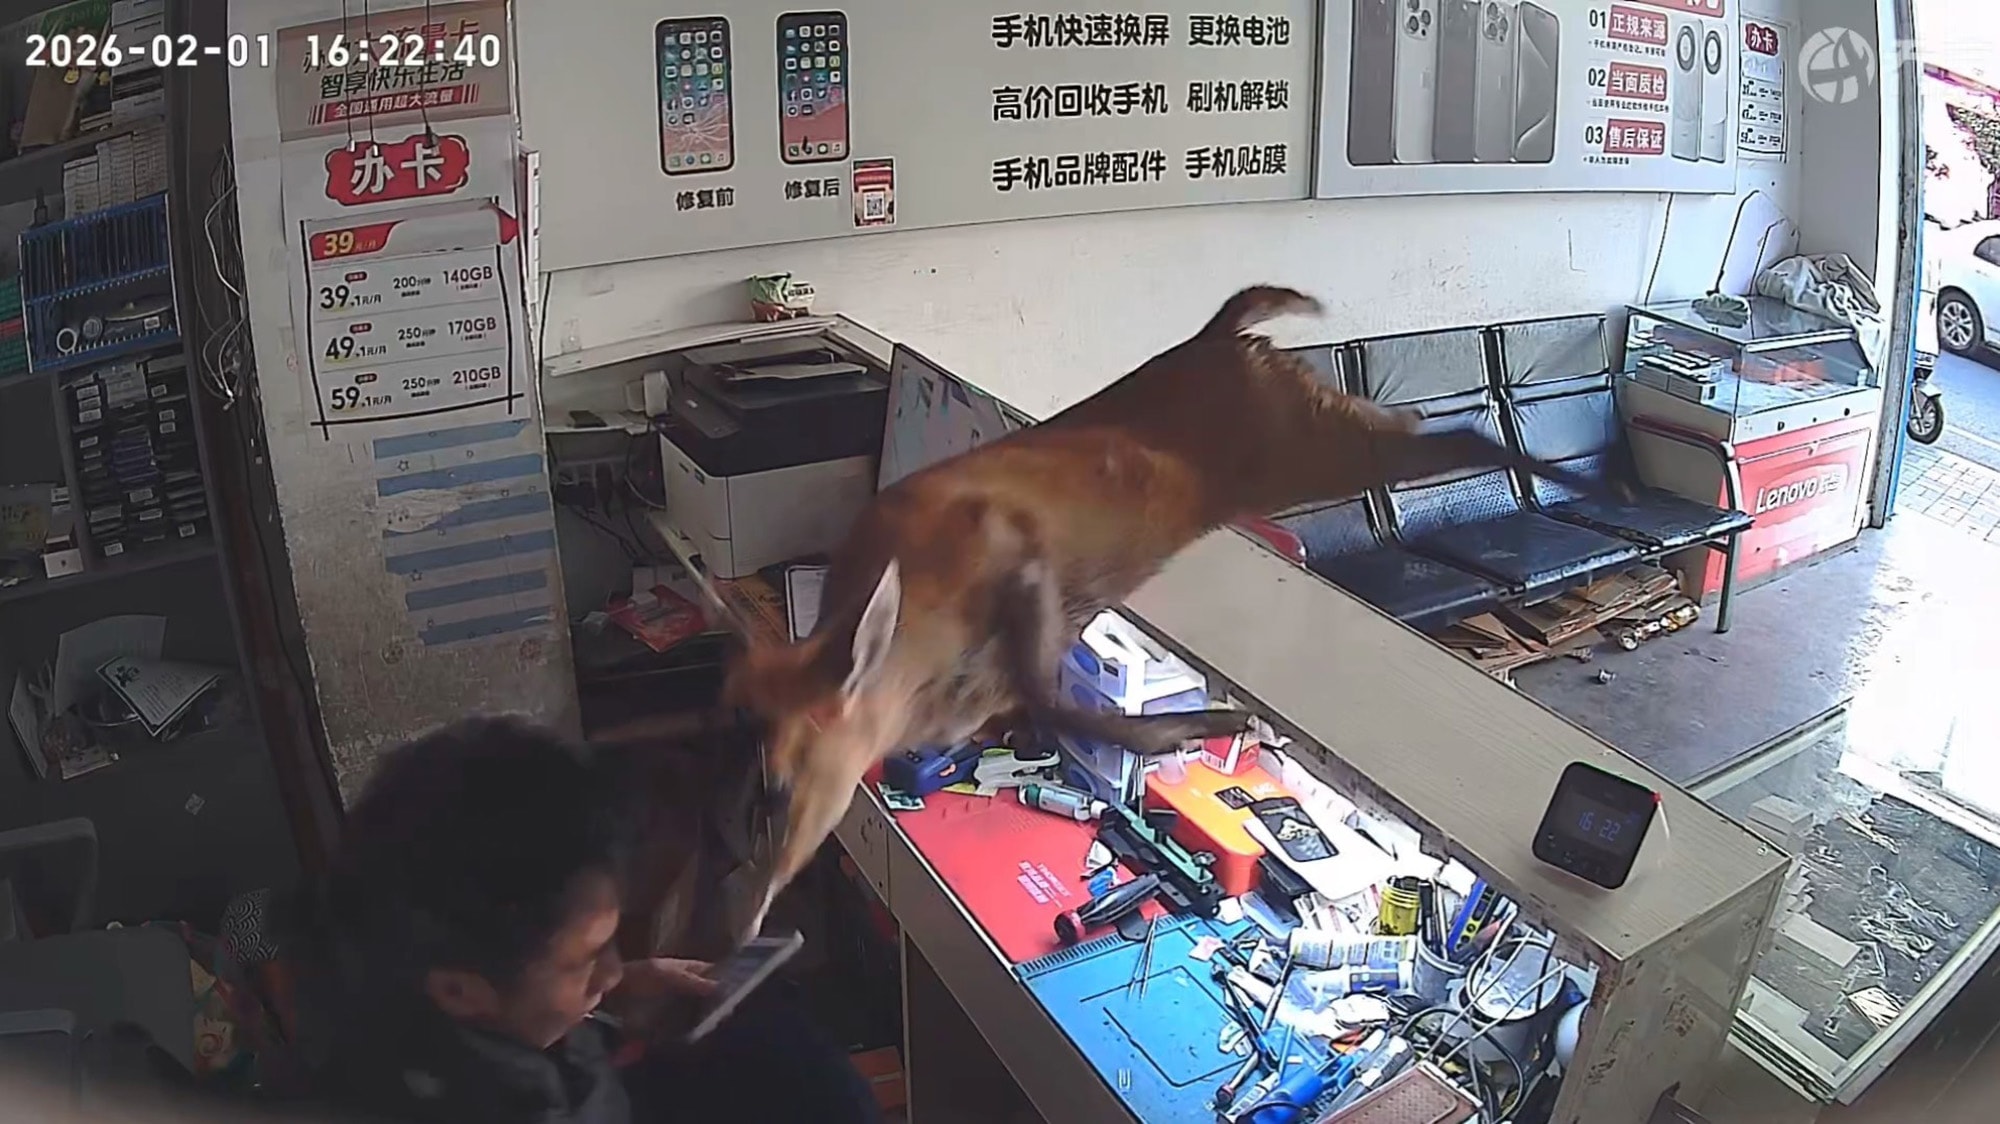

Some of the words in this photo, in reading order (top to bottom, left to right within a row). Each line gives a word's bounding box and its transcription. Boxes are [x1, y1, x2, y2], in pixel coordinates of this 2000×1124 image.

[992, 13, 1170, 48] 手机快速换屏
[1188, 14, 1290, 46] 更换电池
[1589, 9, 1606, 29] 01
[1611, 12, 1666, 40] 正规来源
[1588, 67, 1606, 87] 02
[1611, 69, 1665, 96] 当面质检
[992, 82, 1169, 121] 高价回收手机
[1186, 80, 1290, 113] 刷机解锁
[1585, 125, 1603, 144] 03
[1608, 126, 1663, 150] 售后保证
[350, 142, 446, 196] 办卡
[992, 149, 1167, 192] 手机品牌配件
[1184, 144, 1288, 178] 手机贴膜
[675, 187, 735, 212] 修复前
[784, 178, 841, 200] 修复后
[443, 265, 494, 285] 140GB
[448, 316, 497, 336] 170GB
[452, 366, 502, 385] 210GB
[1756, 476, 1819, 514] Lenovo
